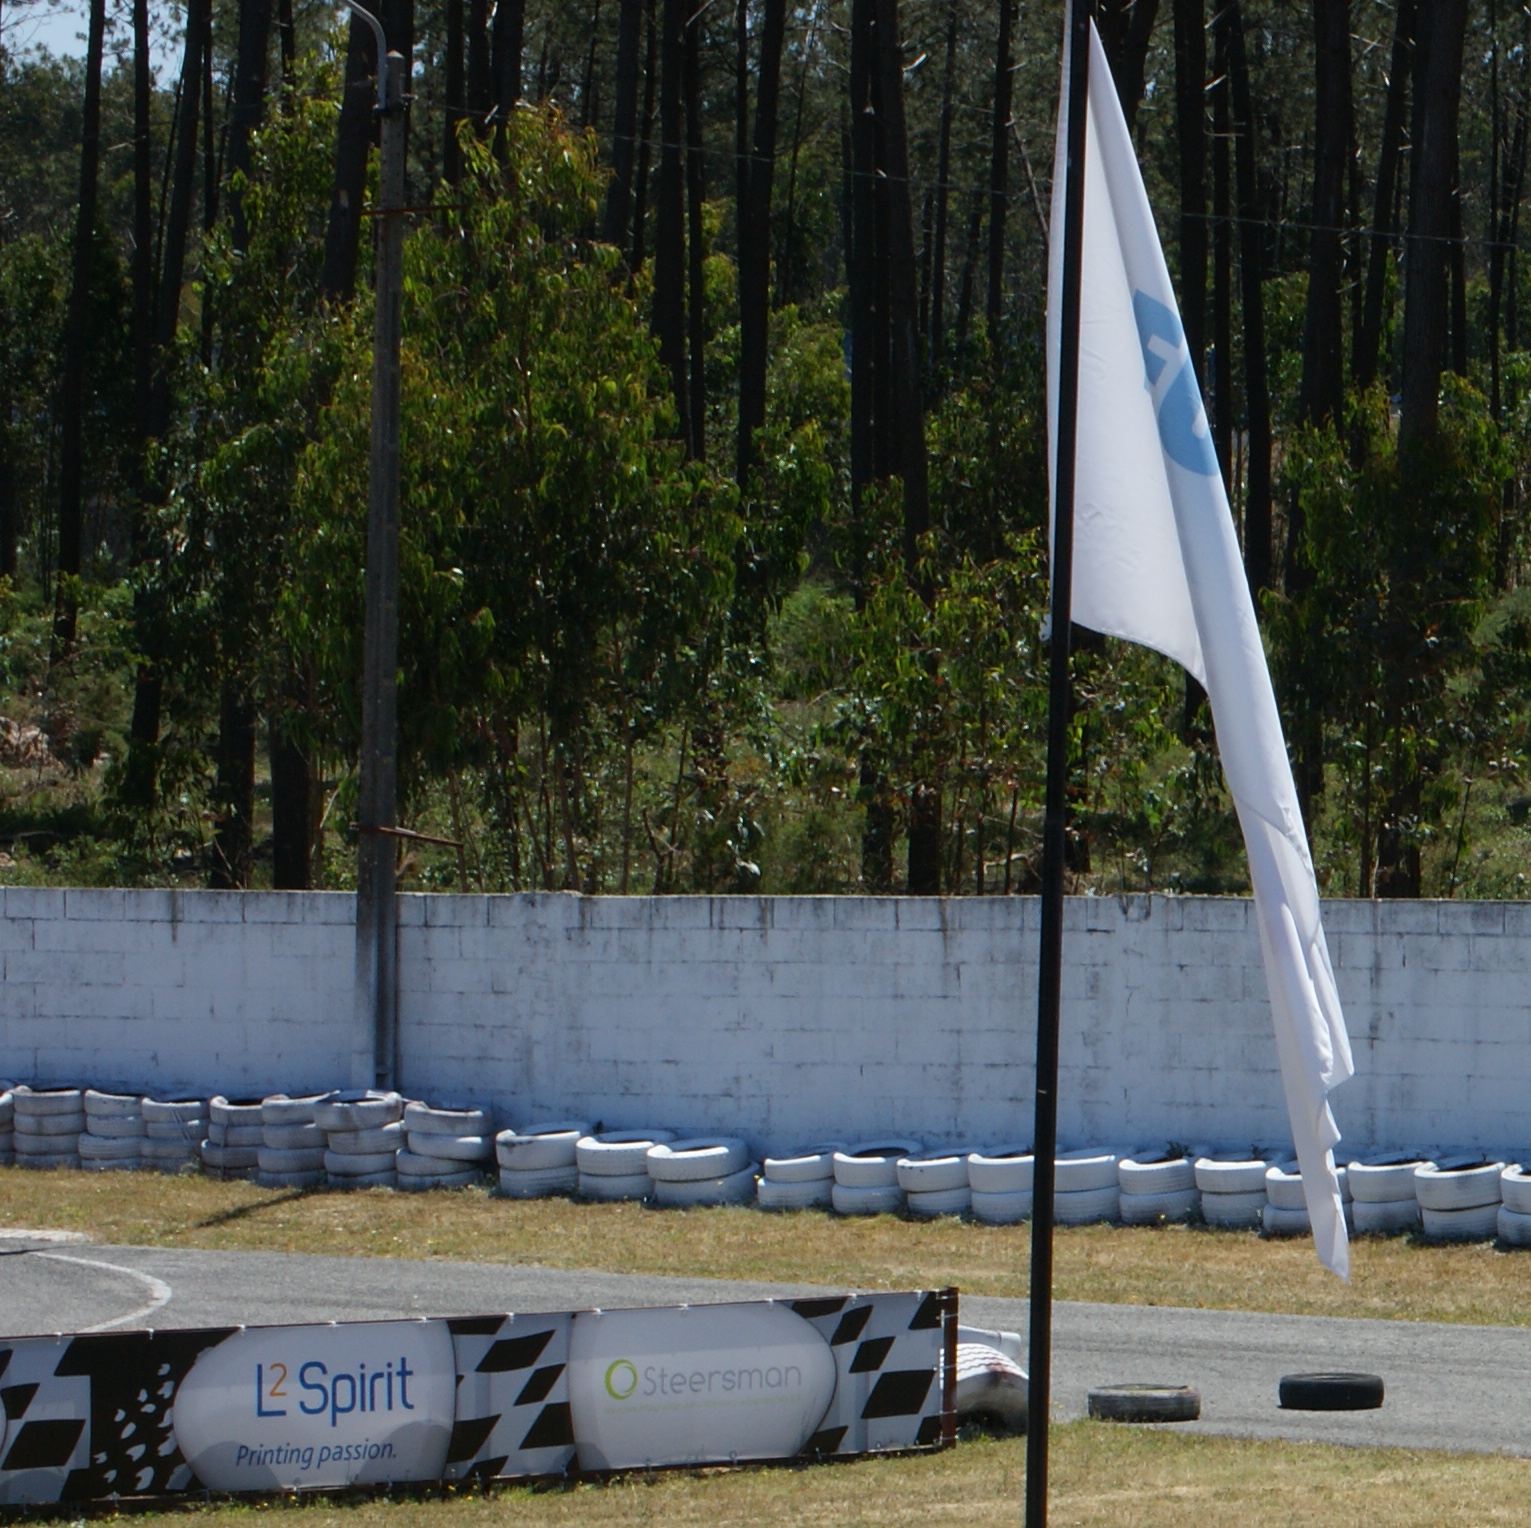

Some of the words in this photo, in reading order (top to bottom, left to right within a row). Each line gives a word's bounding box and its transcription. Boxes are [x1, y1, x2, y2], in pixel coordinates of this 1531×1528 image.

[299, 1356, 414, 1428] Spirit
[643, 1364, 802, 1397] Steersman
[236, 1443, 313, 1471] Printing
[317, 1440, 398, 1467] passion.
